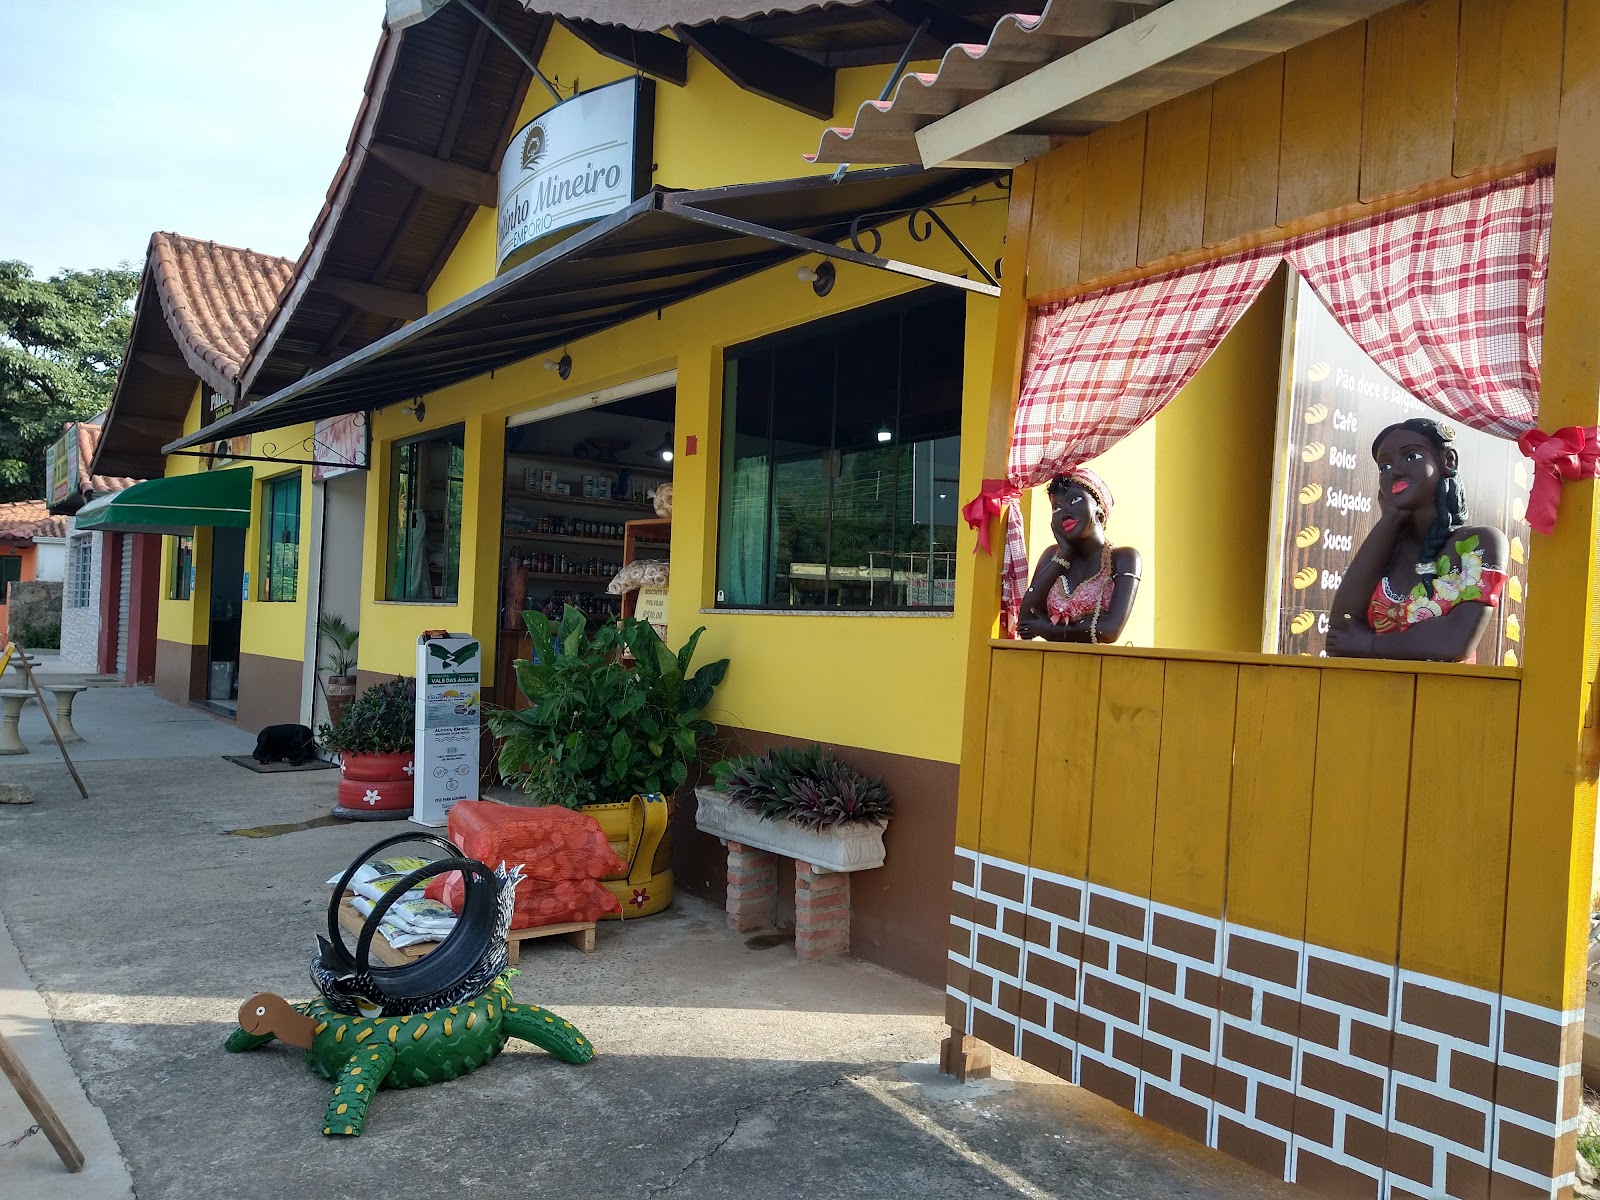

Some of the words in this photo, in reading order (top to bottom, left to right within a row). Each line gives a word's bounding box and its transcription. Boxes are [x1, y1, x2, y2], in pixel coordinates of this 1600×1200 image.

[533, 162, 621, 214] Mineiro
[513, 213, 552, 247] EMPÓRIO
[1335, 367, 1355, 391] Pão
[1357, 374, 1380, 398] doce
[1382, 385, 1389, 401] e
[1333, 408, 1357, 433] Café
[1329, 445, 1357, 470] Bolos
[1326, 486, 1371, 516] Salgados
[1322, 528, 1352, 552] Sucos
